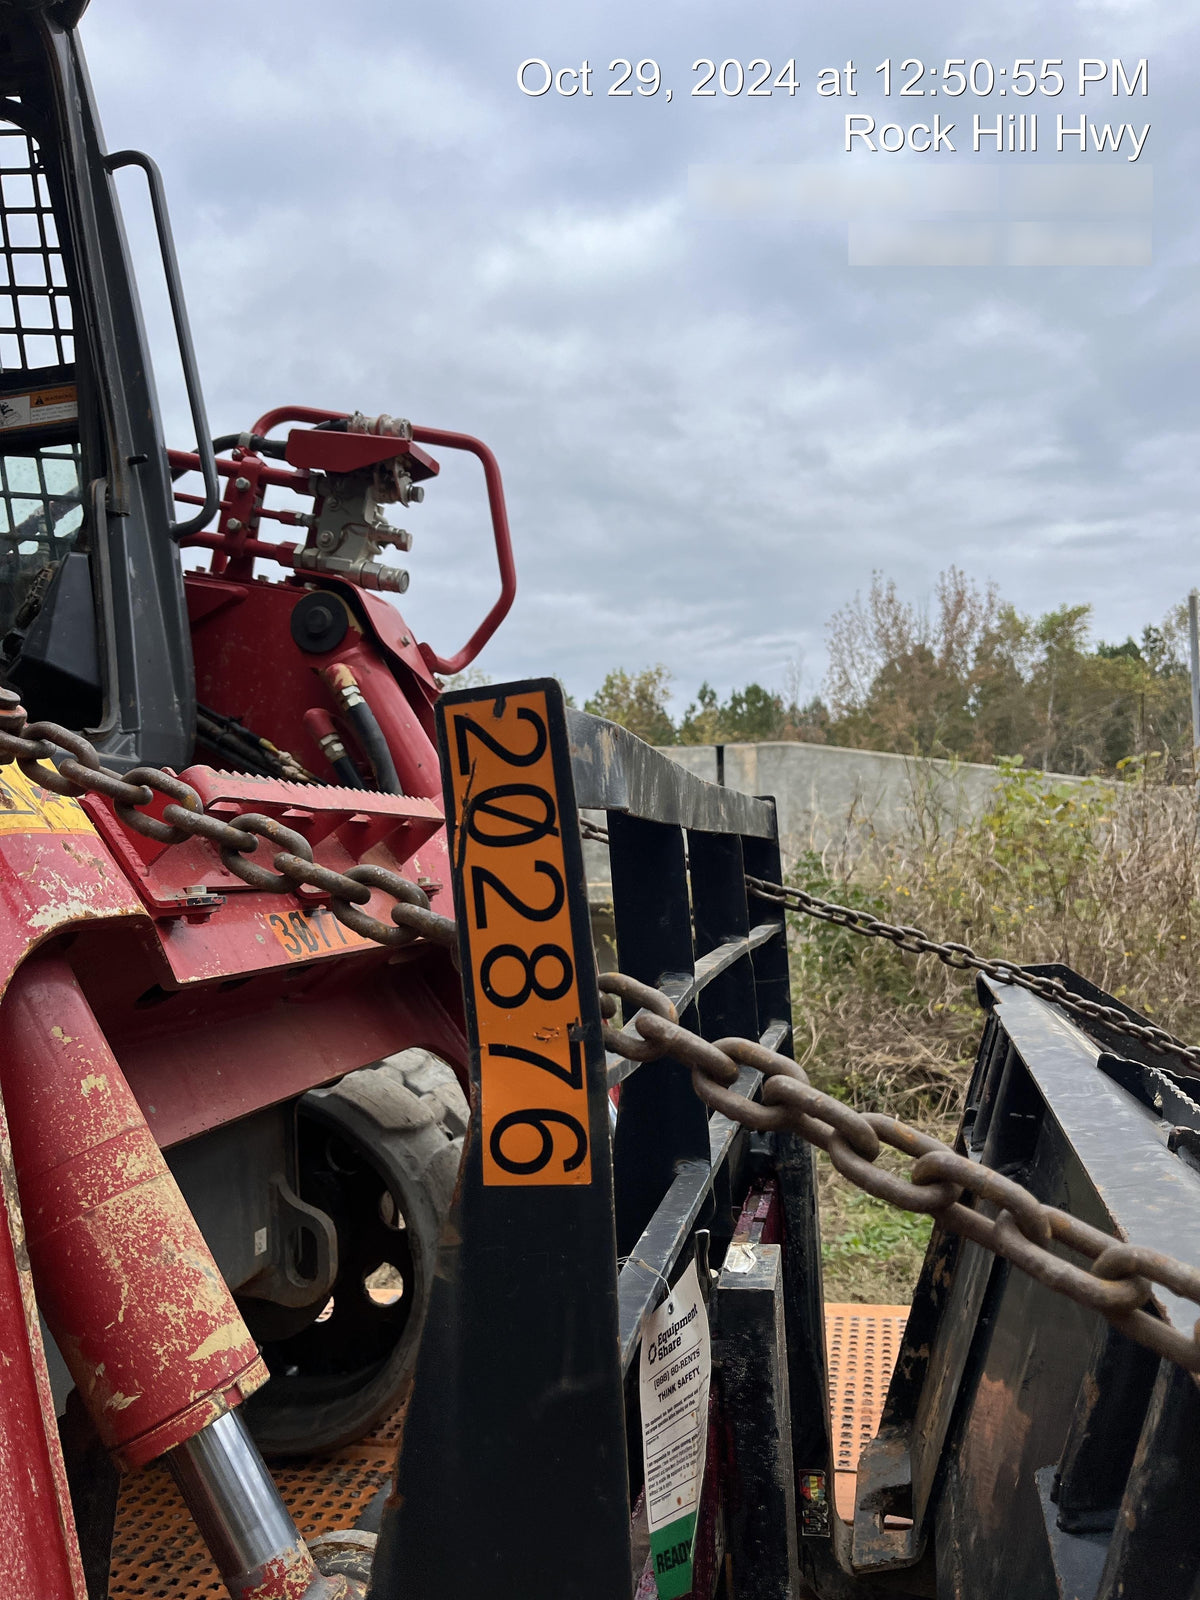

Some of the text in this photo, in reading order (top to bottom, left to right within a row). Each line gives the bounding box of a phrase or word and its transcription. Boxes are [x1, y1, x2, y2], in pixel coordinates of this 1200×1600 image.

[269, 909, 367, 955] 3077
[454, 706, 588, 1176] 202876
[657, 1303, 698, 1346] Equipment
[657, 1336, 682, 1361] Share
[657, 1366, 700, 1403] THINK SAFETY
